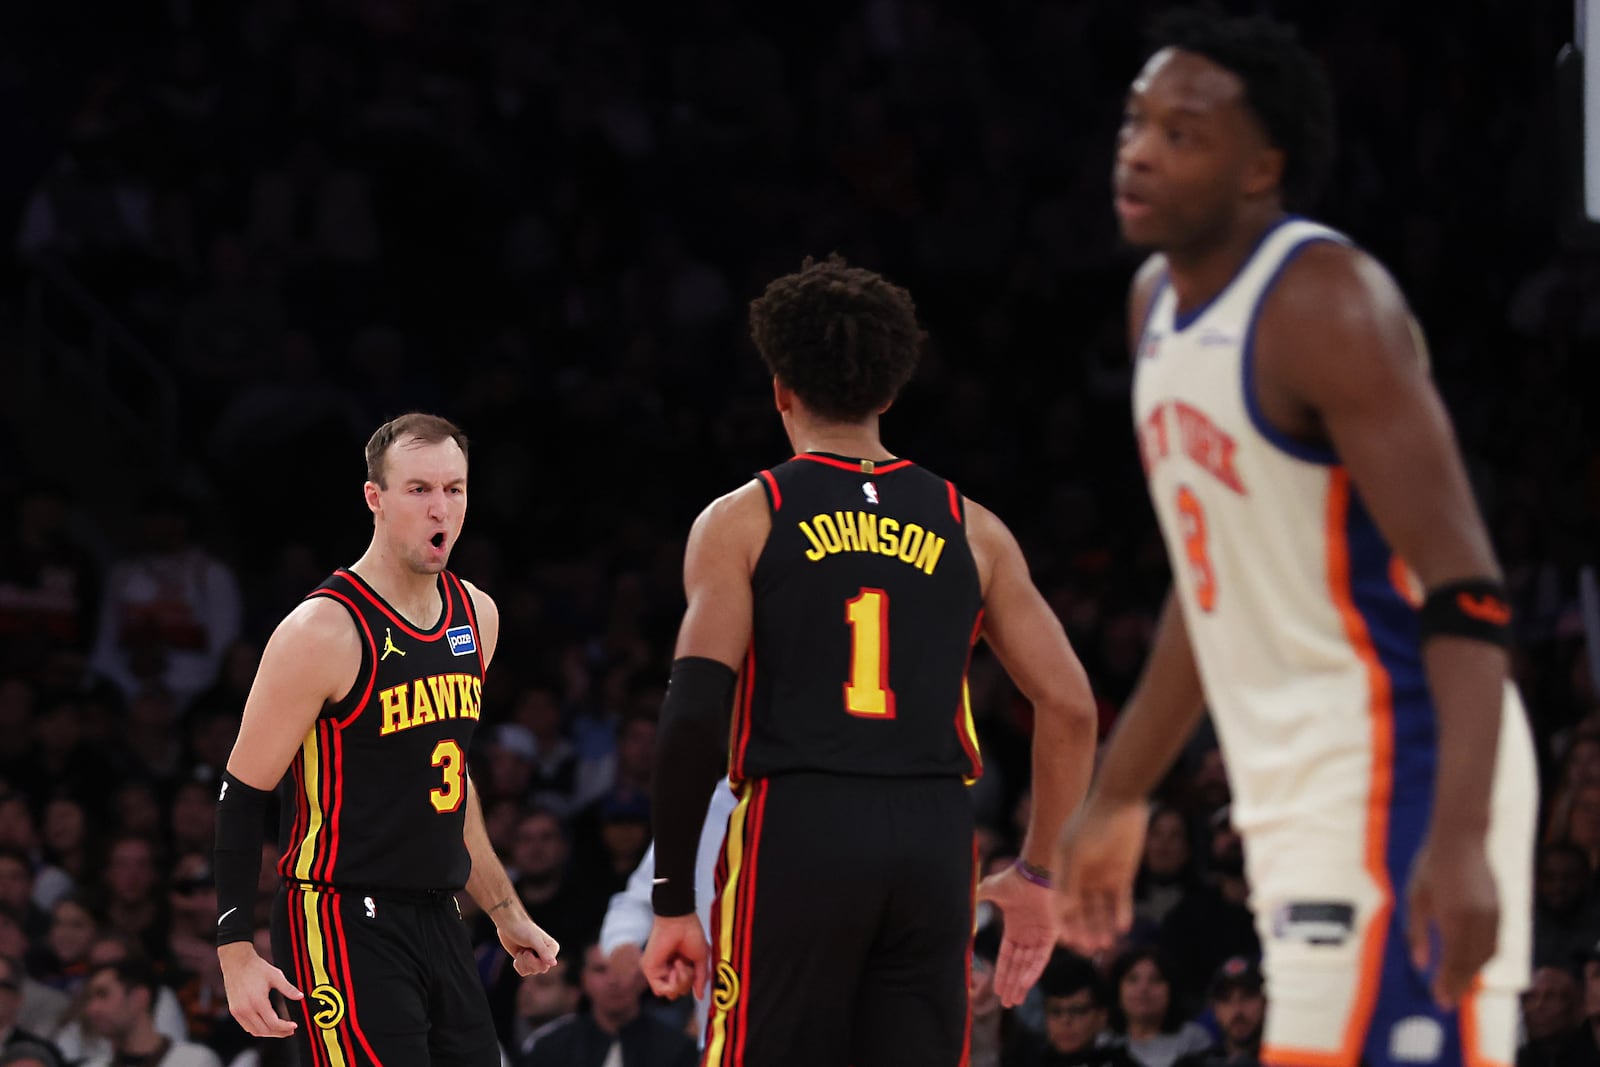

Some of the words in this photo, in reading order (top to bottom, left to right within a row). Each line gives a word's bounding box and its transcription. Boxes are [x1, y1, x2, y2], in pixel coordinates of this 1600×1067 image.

[798, 511, 946, 575] JOHNSON
[1174, 484, 1217, 614] 3
[450, 633, 472, 649] paze
[844, 586, 896, 719] 1
[379, 673, 482, 736] HAWKS
[430, 739, 465, 814] 3
